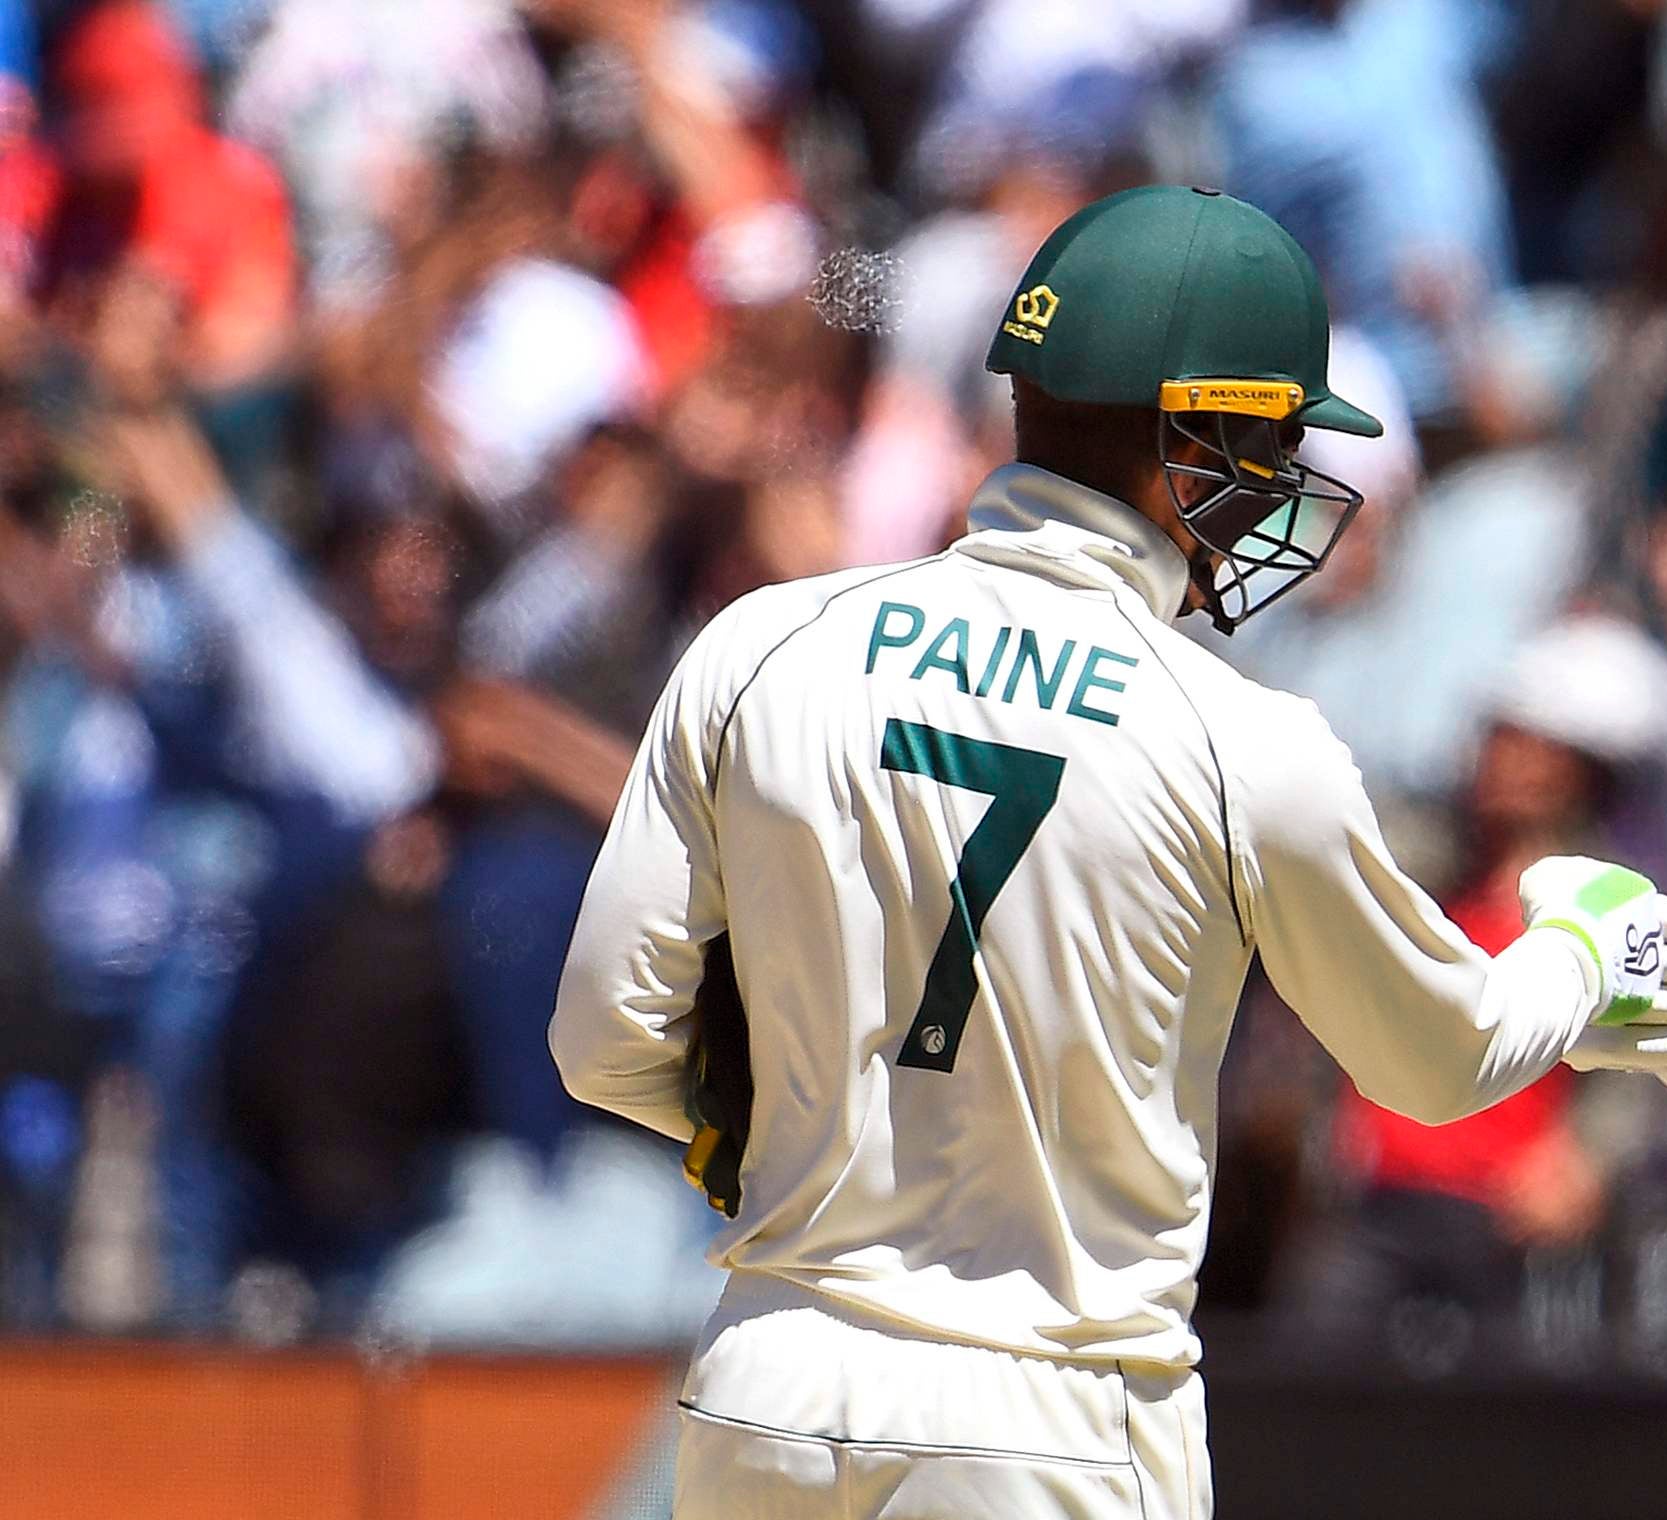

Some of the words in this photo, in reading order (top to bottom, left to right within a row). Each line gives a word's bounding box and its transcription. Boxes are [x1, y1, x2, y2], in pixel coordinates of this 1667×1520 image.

[1209, 389, 1281, 401] MASURI
[864, 600, 1140, 727] PAINE
[879, 717, 1068, 1074] 7
